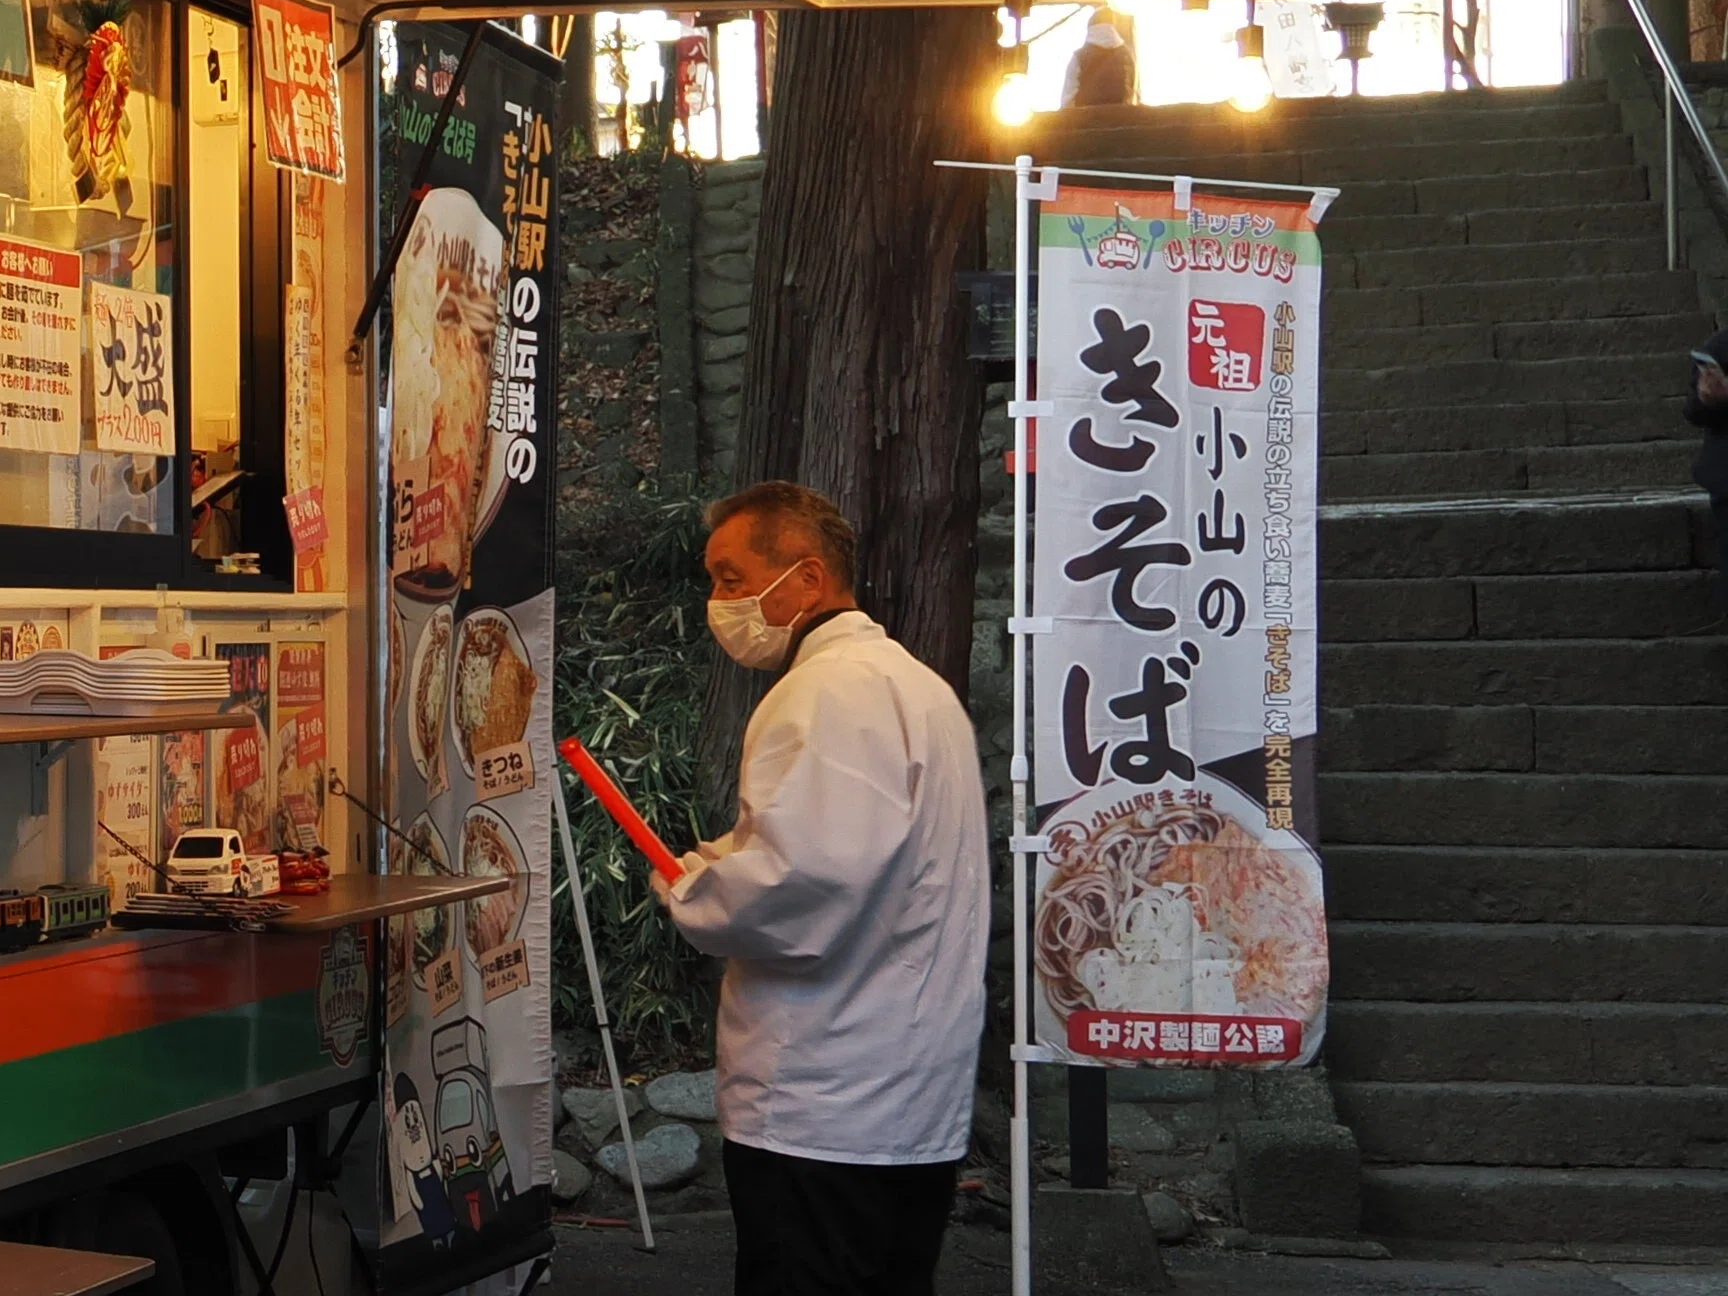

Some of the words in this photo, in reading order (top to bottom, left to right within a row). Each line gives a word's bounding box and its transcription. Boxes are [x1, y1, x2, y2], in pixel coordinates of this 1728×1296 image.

[285, 21, 328, 92] 注文
[292, 88, 331, 156] 会計
[1185, 208, 1276, 239] キッチン
[0, 249, 54, 277] お客様へお願い
[1162, 237, 1297, 285] CIRCUS
[504, 112, 553, 485] 小山駅の伝説の
[99, 299, 170, 417] 大盛
[1188, 304, 1256, 392] 元祖
[288, 499, 322, 529] 売り切れ
[1195, 405, 1248, 640] 小山の
[1060, 306, 1200, 788] きそば
[1263, 300, 1297, 832] 小山駅の伝説の立ち食い蕎麦「きそば」を完全再現
[230, 736, 258, 765] 売り切れ
[298, 717, 324, 742] 売り切れ
[480, 751, 524, 778] きつね
[433, 960, 455, 989] 山菜
[1087, 1017, 1287, 1058] 中沢製麺公認
